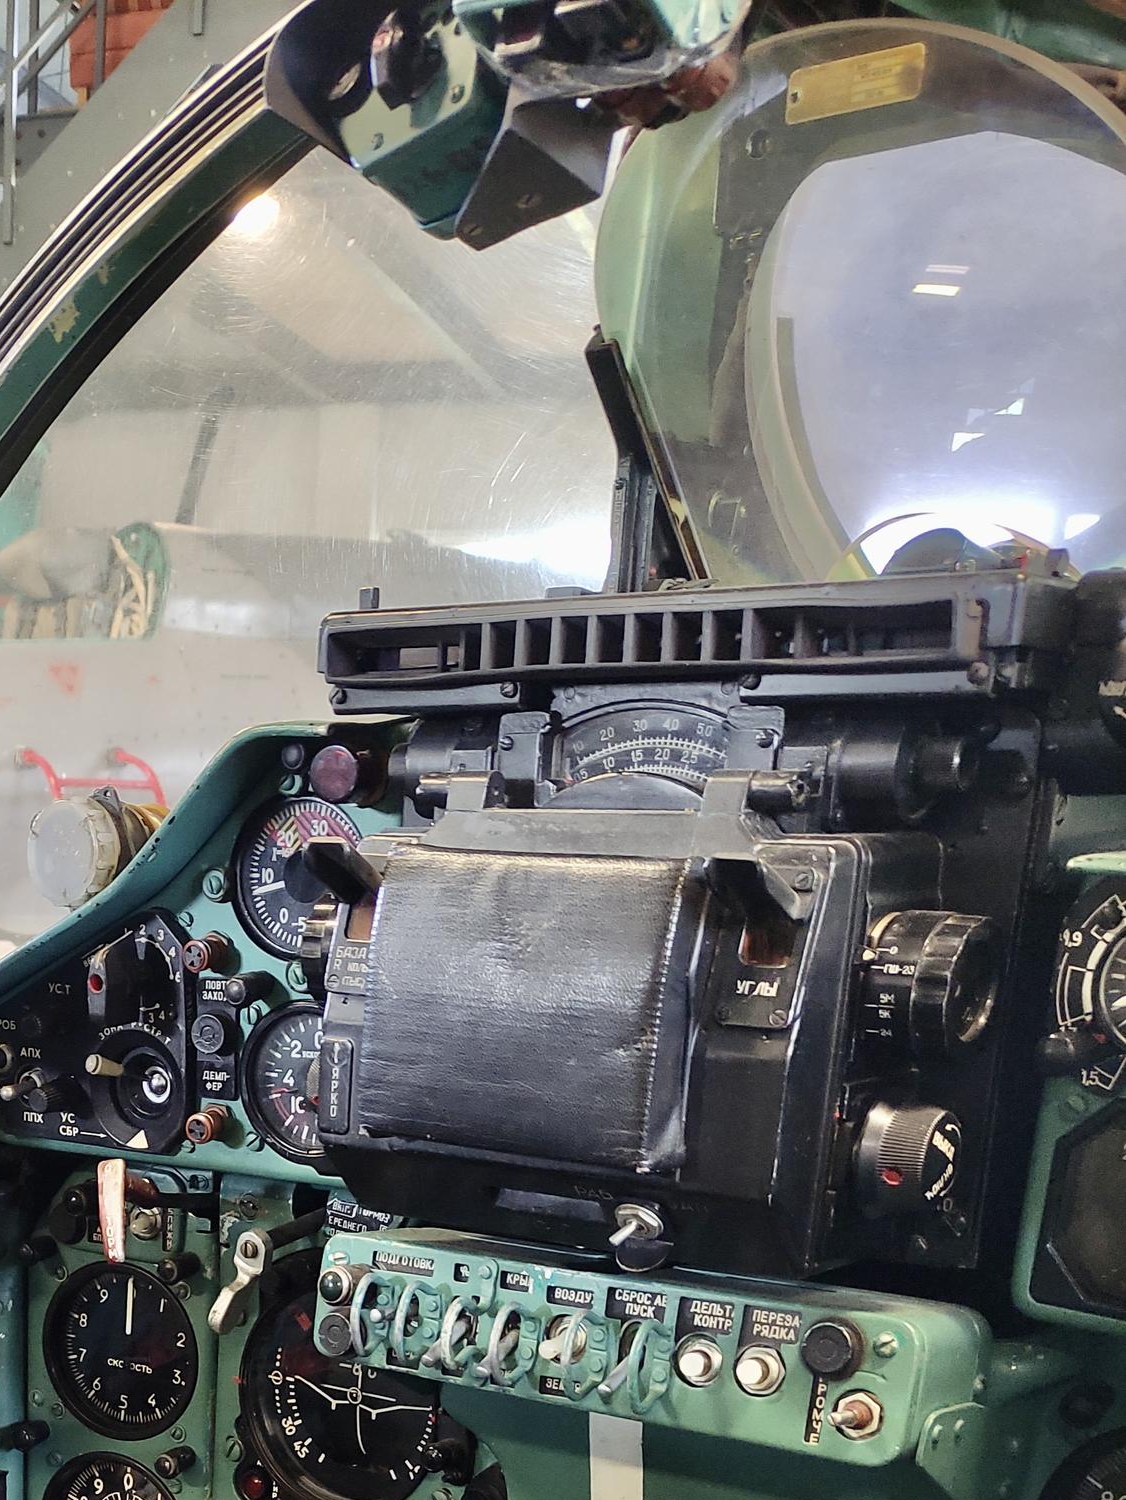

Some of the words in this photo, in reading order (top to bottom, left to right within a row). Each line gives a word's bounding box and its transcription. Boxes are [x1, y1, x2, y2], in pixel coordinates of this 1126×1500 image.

[312, 820, 328, 835] 30
[262, 868, 274, 883] 10
[20, 1047, 41, 1058] АПХ
[205, 1082, 223, 1091] ФЕР
[24, 1112, 44, 1124] ППХ
[59, 1126, 79, 1137] СБР
[100, 1289, 109, 1303] 9
[615, 1289, 652, 1305] СБРОС
[625, 1304, 656, 1319] ПУСК
[80, 1314, 88, 1327] 8
[754, 1325, 795, 1341] РЯДКА
[177, 1333, 186, 1348] 2
[79, 1348, 87, 1362] 7
[93, 1377, 101, 1390] 6
[119, 1395, 128, 1409] 5
[94, 1479, 104, 1495] 9
